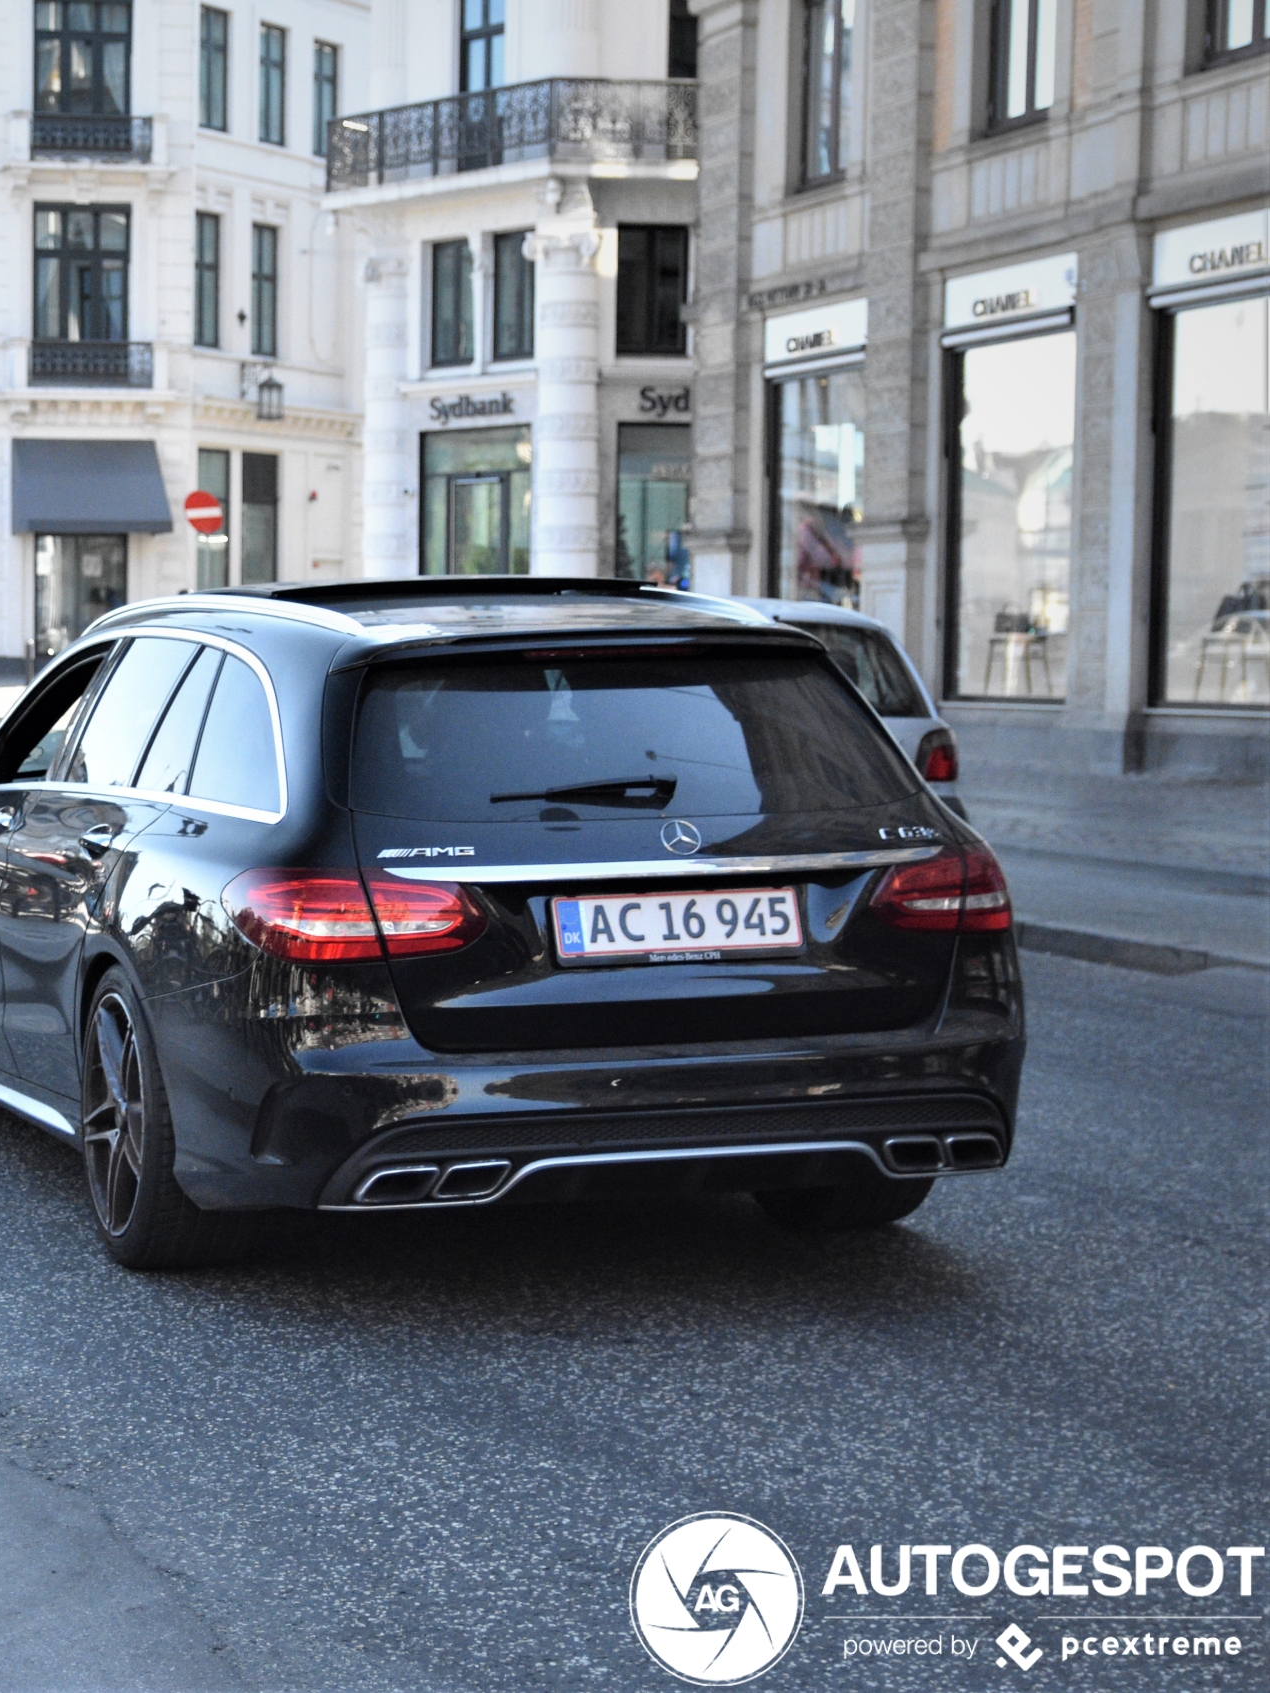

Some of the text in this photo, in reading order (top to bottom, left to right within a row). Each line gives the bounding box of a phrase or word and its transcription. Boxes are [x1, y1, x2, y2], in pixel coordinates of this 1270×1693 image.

[1188, 241, 1270, 274] CHANEL
[973, 290, 1035, 317] CHANEL
[430, 391, 514, 425] Sydbank
[408, 846, 476, 858] AMG
[590, 896, 790, 943] AC 16 945
[564, 931, 581, 945] DK
